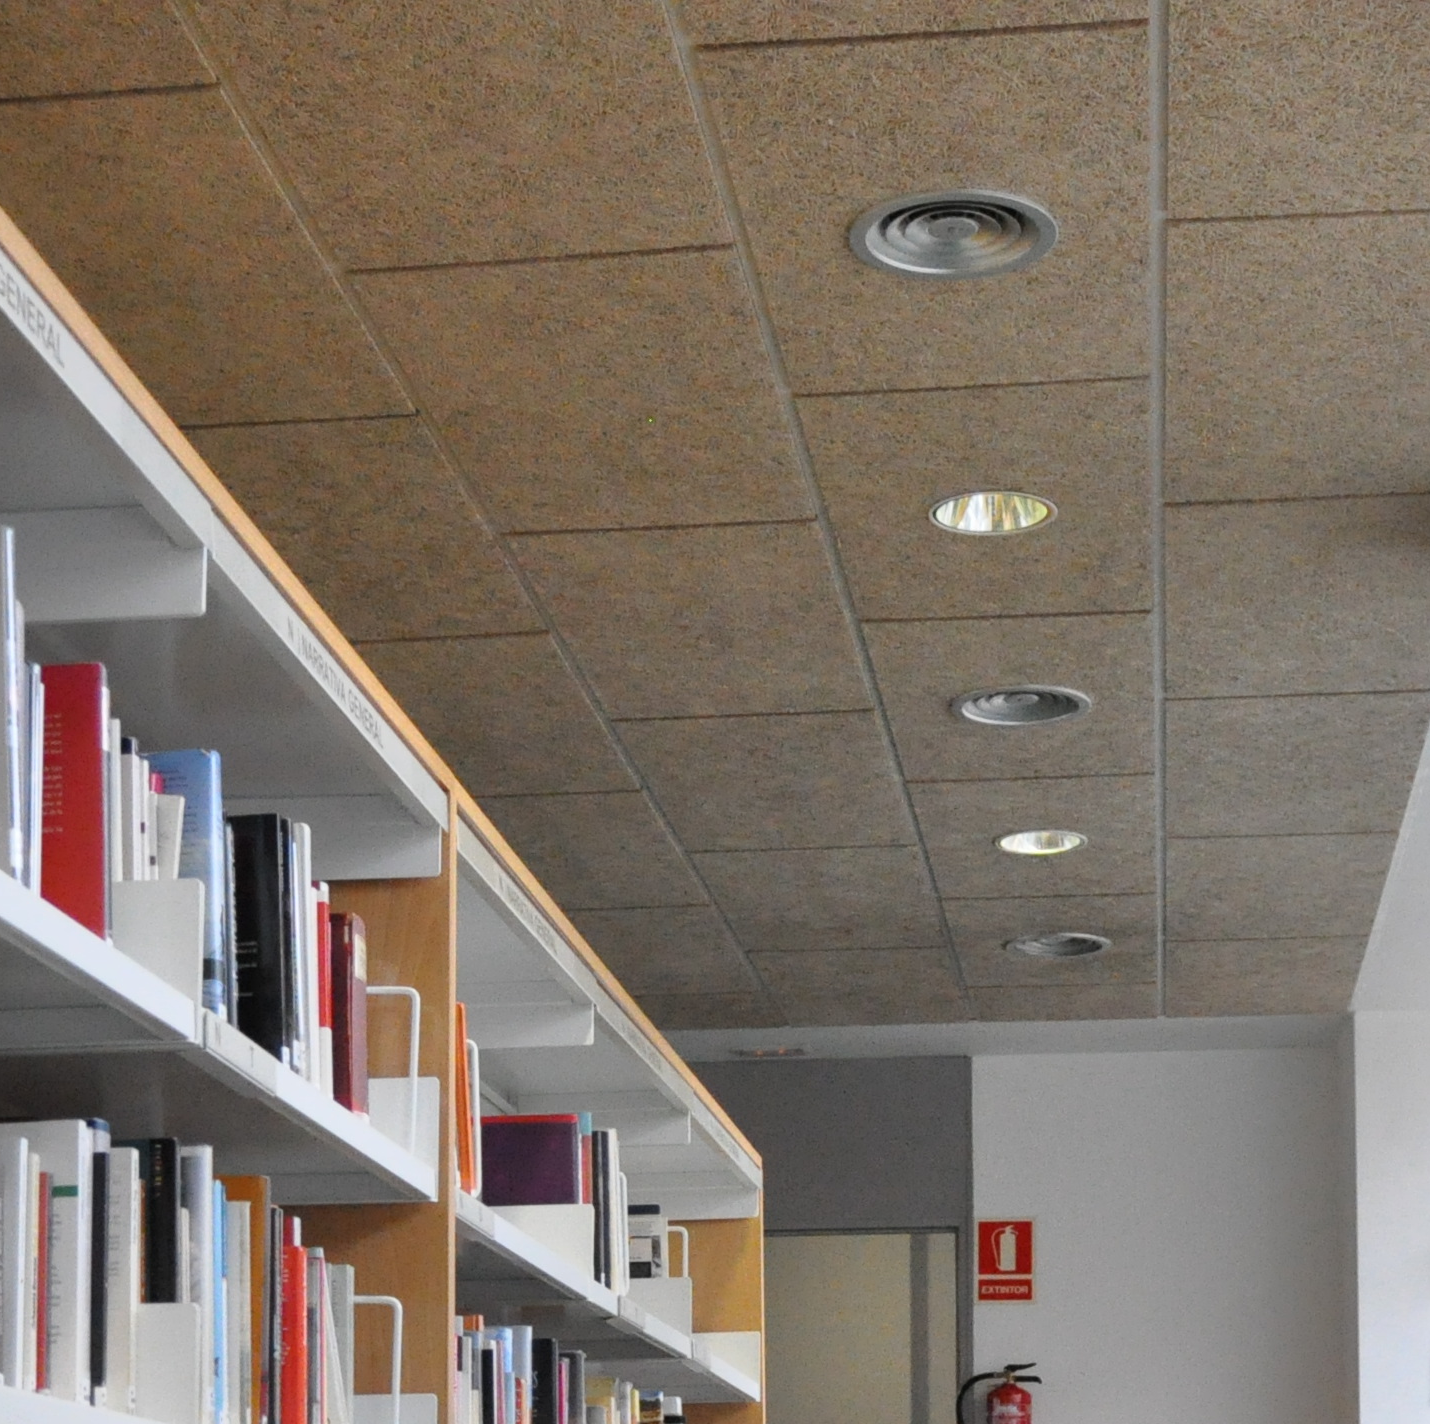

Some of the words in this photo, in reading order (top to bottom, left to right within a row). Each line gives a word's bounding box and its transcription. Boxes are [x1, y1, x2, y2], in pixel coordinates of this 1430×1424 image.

[301, 636, 347, 705] NARRATIVA
[347, 685, 385, 750] GENERAL
[981, 1284, 1029, 1295] EXTINTOR
